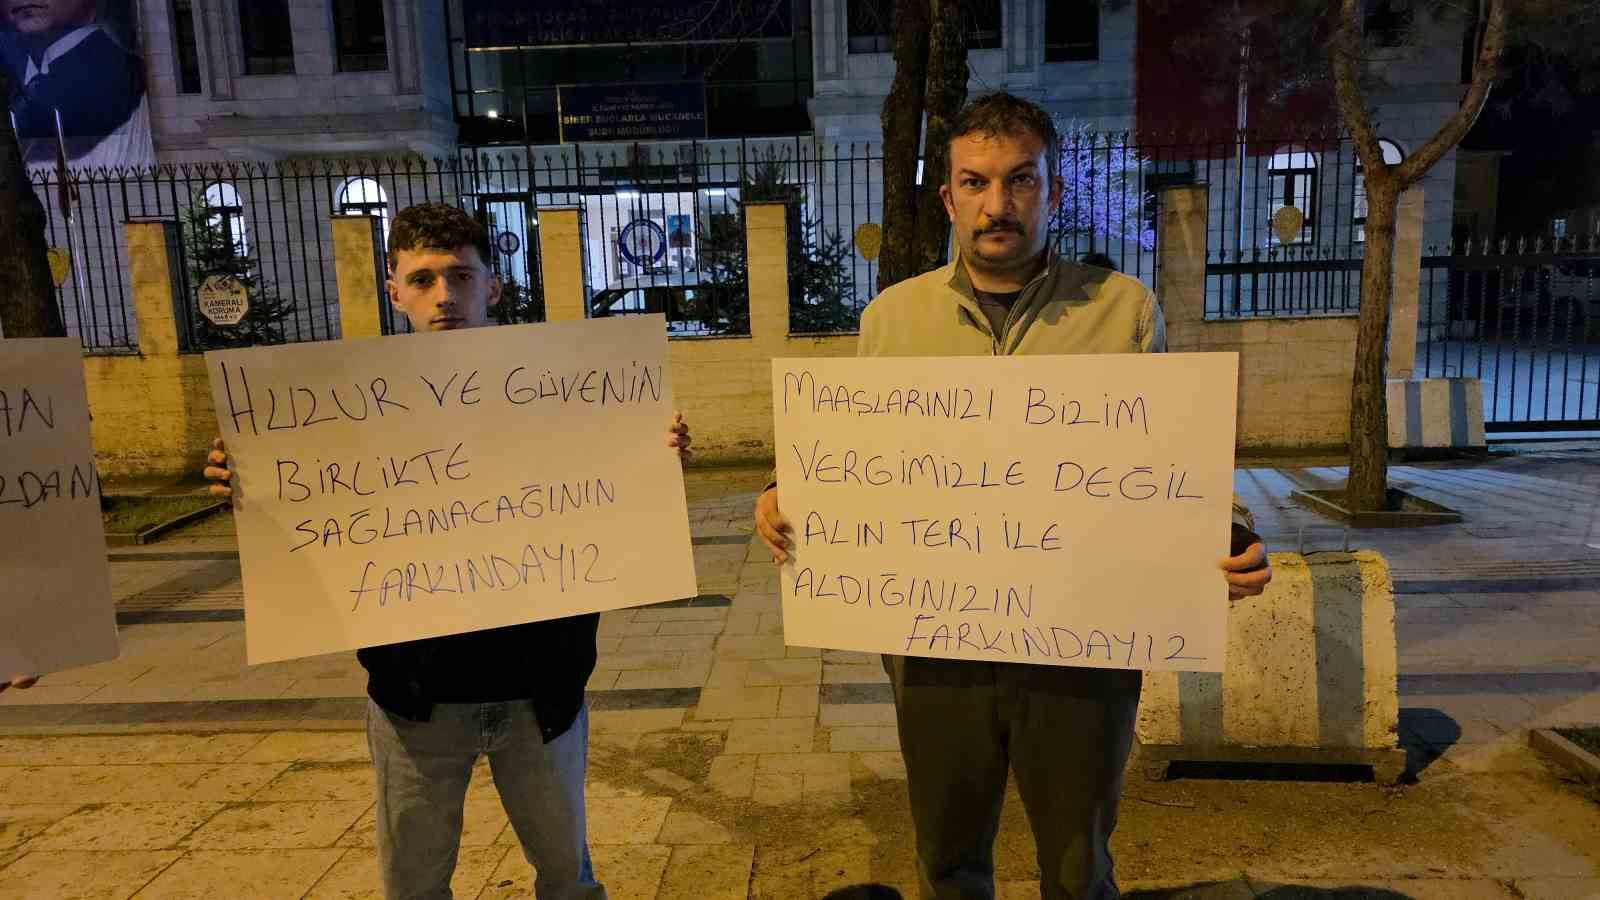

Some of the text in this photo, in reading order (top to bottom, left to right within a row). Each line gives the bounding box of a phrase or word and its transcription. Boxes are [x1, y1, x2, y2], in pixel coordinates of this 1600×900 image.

[221, 361, 662, 436] HUZUR VE GÜVENİN
[784, 370, 1150, 434] MAAŞLARINIZI BİZİM
[277, 443, 471, 502] BİRLİKTE
[793, 440, 1204, 500] VERGİMİZLE DEĞİL
[290, 478, 616, 552] SAĞLANACAĞININ
[805, 511, 1064, 553] ALIN TERİ İLE
[794, 567, 1032, 619] ALDIĞINIZIN
[905, 613, 1207, 661] FARKINDAYIZ
